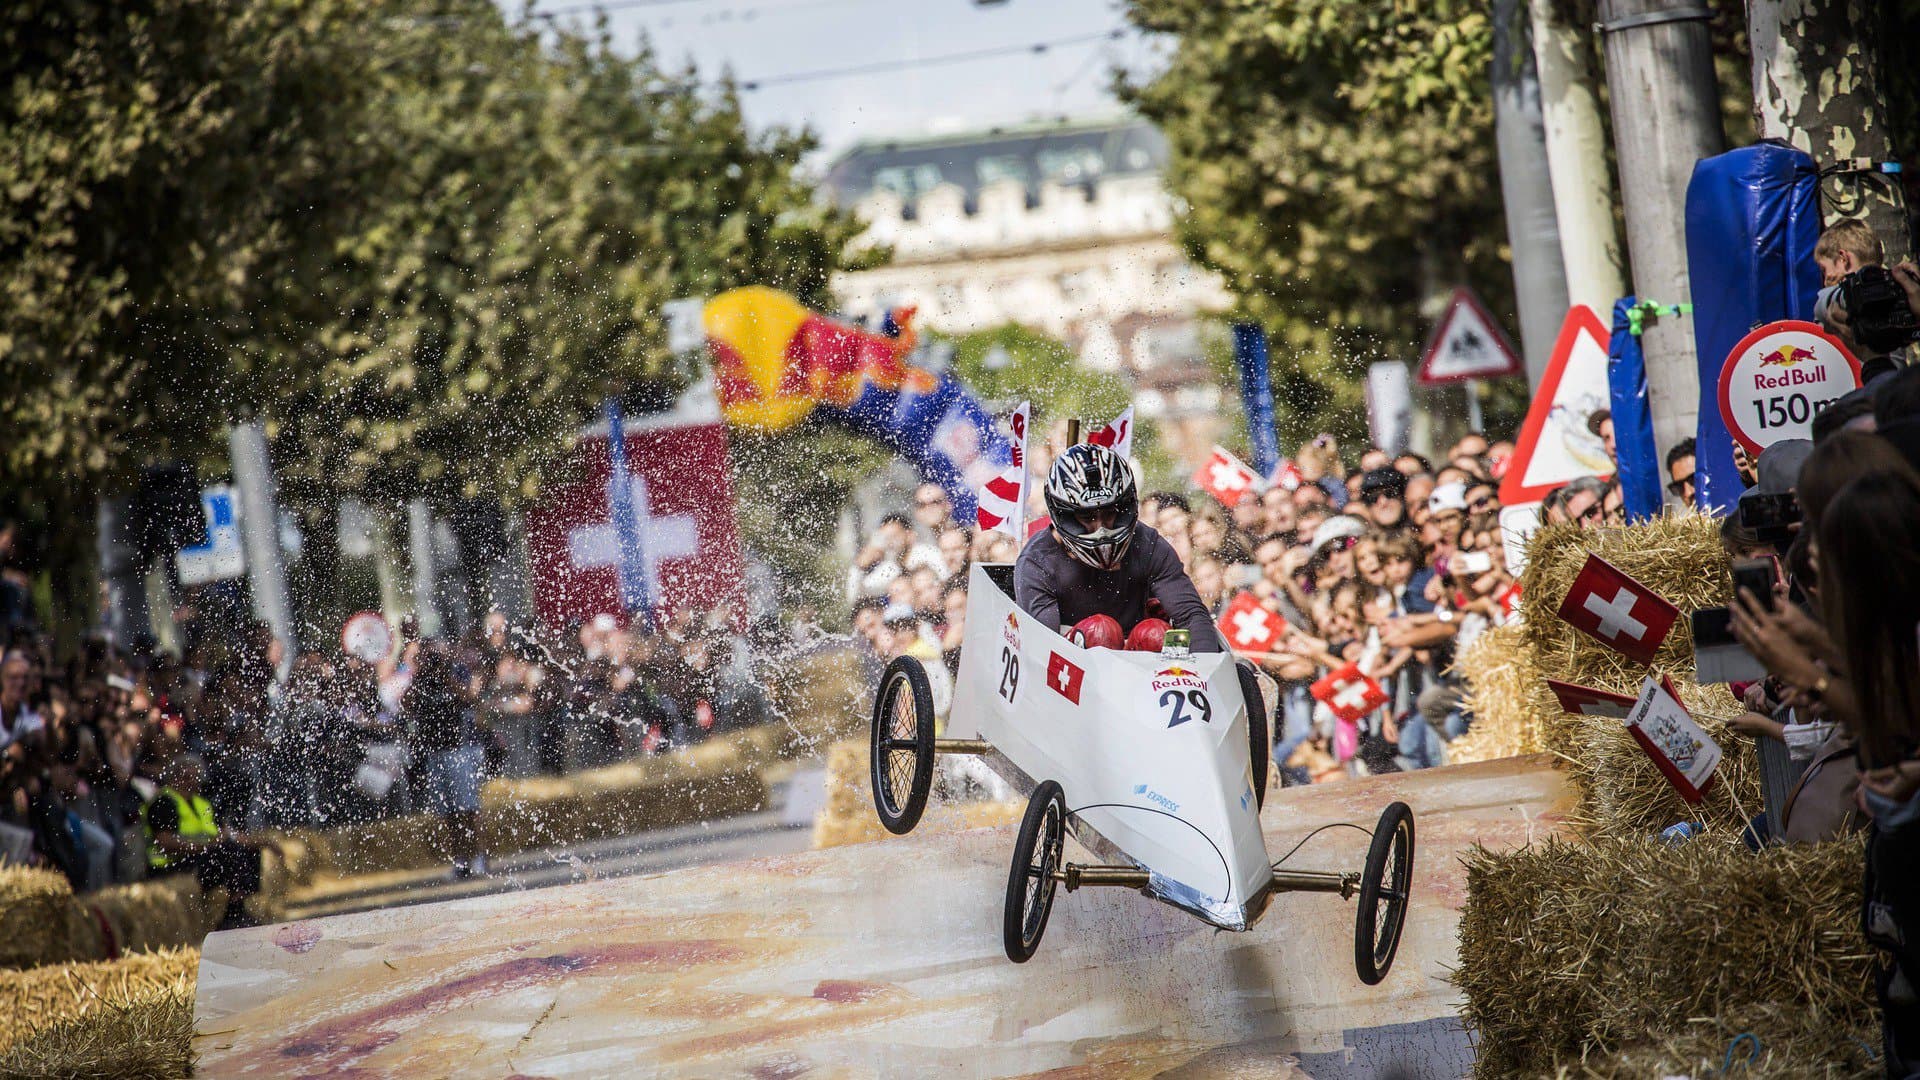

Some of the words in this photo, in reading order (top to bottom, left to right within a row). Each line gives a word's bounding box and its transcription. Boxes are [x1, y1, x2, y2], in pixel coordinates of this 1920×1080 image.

[1754, 369, 1790, 390] Red
[1791, 365, 1827, 386] Bull
[999, 646, 1019, 704] 29
[1151, 678, 1181, 692] Red
[1181, 678, 1208, 692] Bull
[1159, 689, 1212, 728] 29
[1146, 791, 1181, 812] EXPRESS
